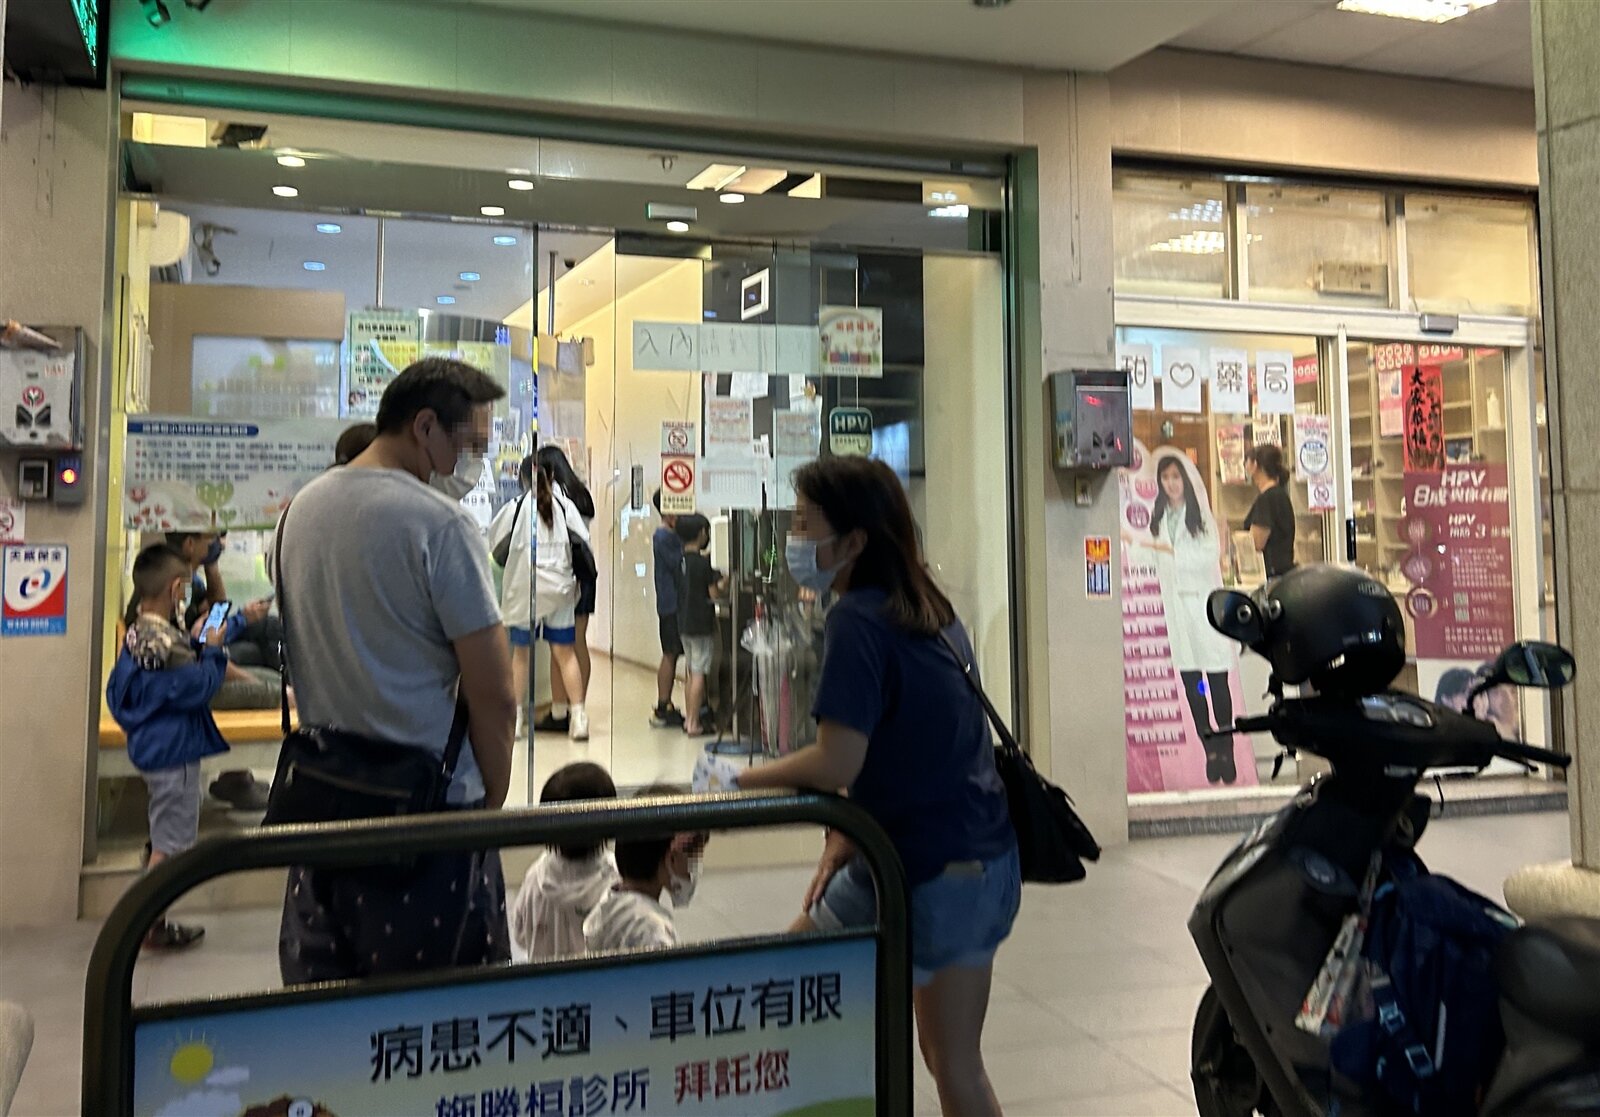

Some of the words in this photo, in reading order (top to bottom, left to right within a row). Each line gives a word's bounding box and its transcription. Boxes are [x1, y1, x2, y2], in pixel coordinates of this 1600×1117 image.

[834, 415, 868, 432] HPV
[1441, 469, 1486, 487] HPV
[1449, 513, 1476, 525] HPV
[674, 1049, 790, 1104] 拜託您
